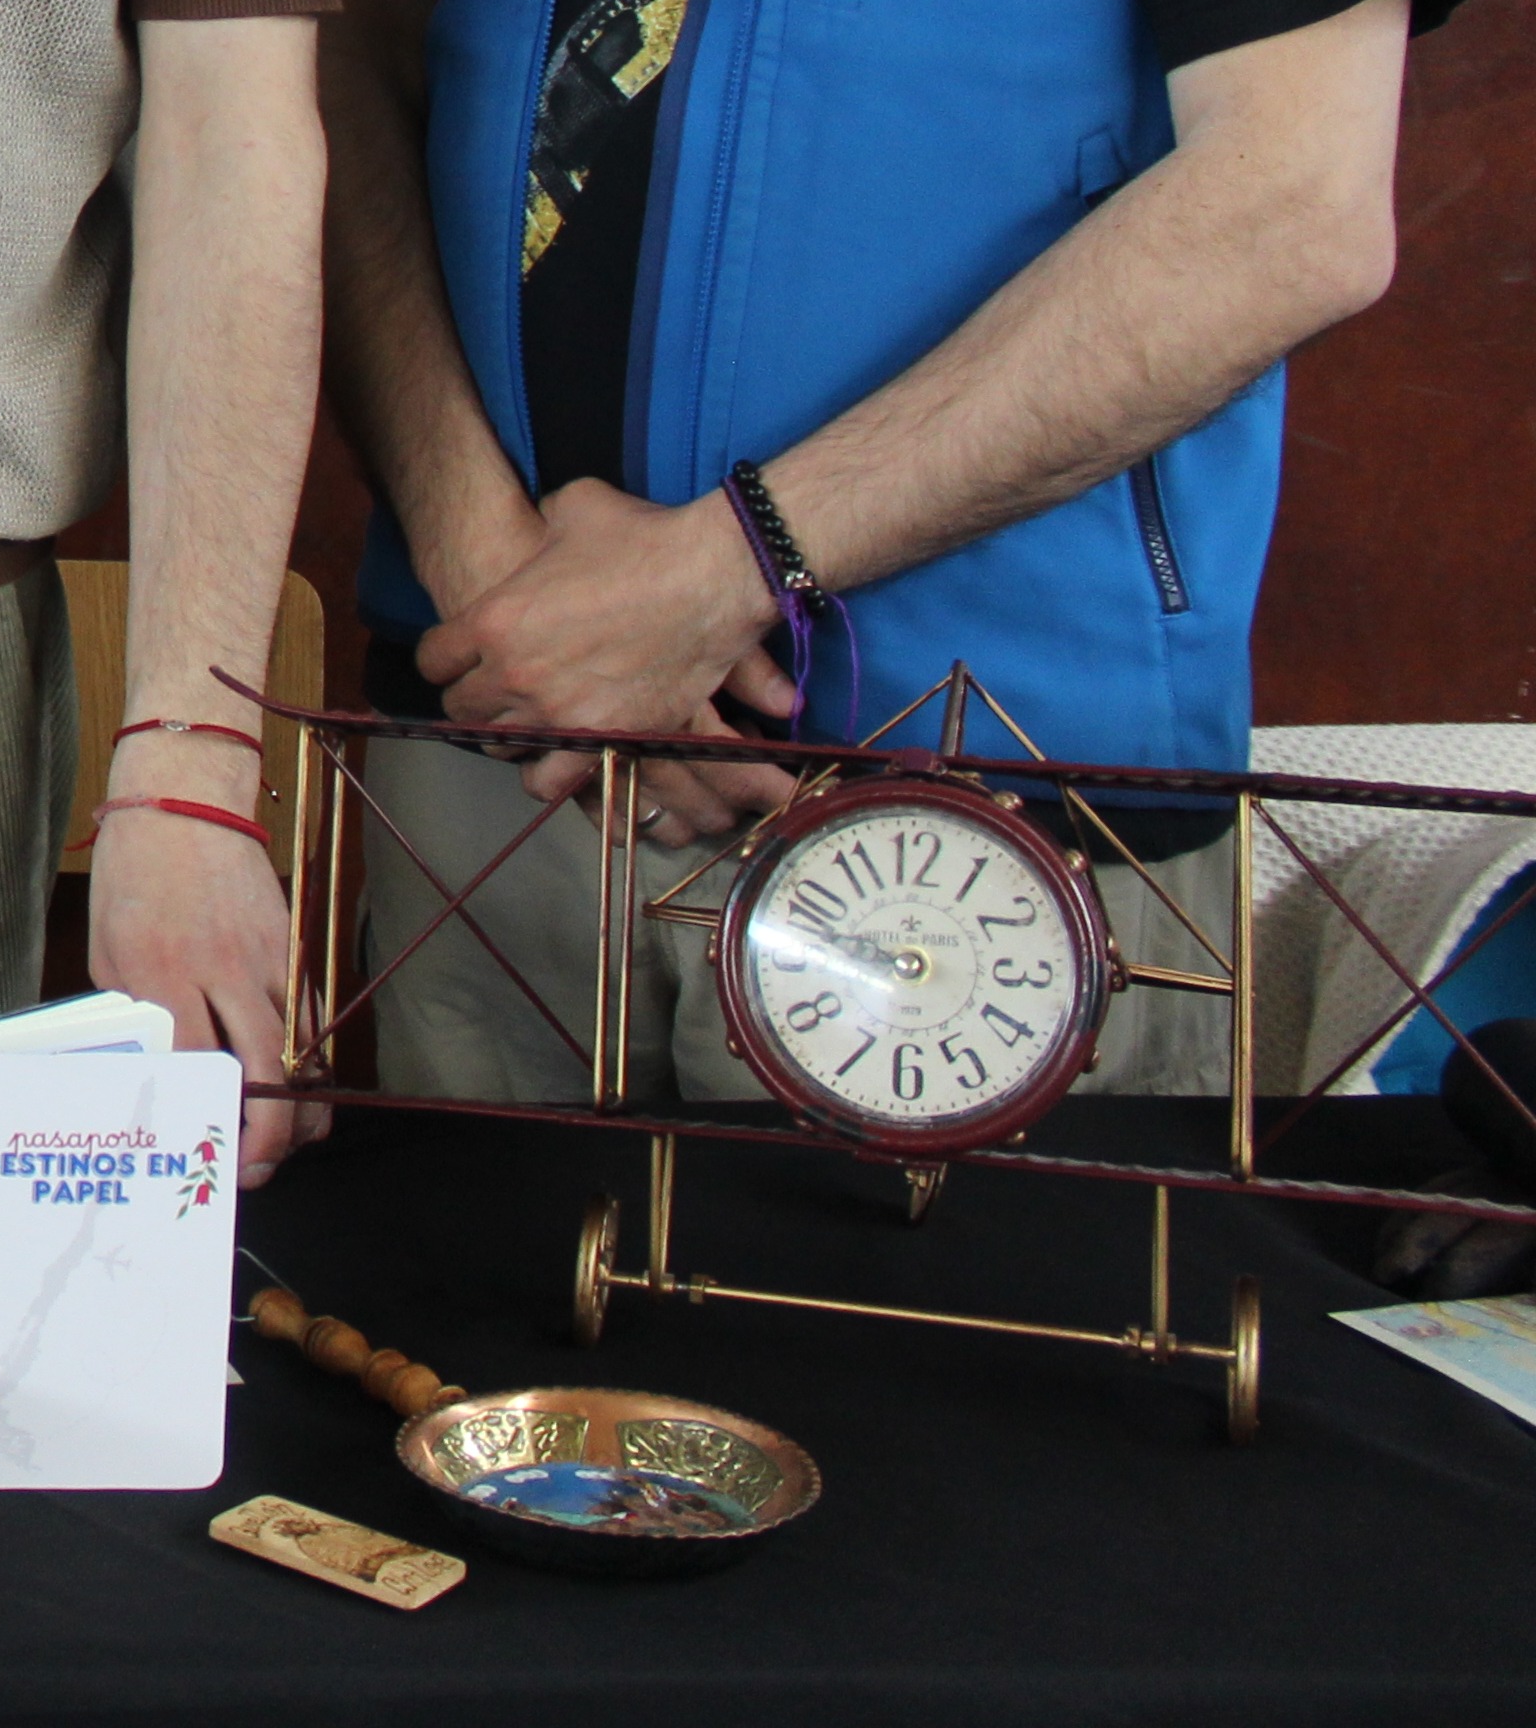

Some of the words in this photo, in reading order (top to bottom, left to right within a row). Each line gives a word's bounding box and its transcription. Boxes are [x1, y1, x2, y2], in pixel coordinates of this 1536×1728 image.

[832, 839, 886, 900] 11
[890, 830, 942, 889] 12
[954, 856, 990, 904] 1
[786, 878, 850, 942] 10
[976, 895, 1037, 943] 2
[922, 933, 960, 948] PARIS
[992, 957, 1054, 989] 3
[785, 990, 845, 1035] 8
[979, 1001, 1036, 1049] 4
[834, 1027, 878, 1078] 7
[891, 1043, 925, 1102] 6
[937, 1031, 988, 1090] 5
[7, 1126, 158, 1156] pasaporte
[146, 1152, 188, 1178] EN
[31, 1180, 131, 1205] PAPEL
